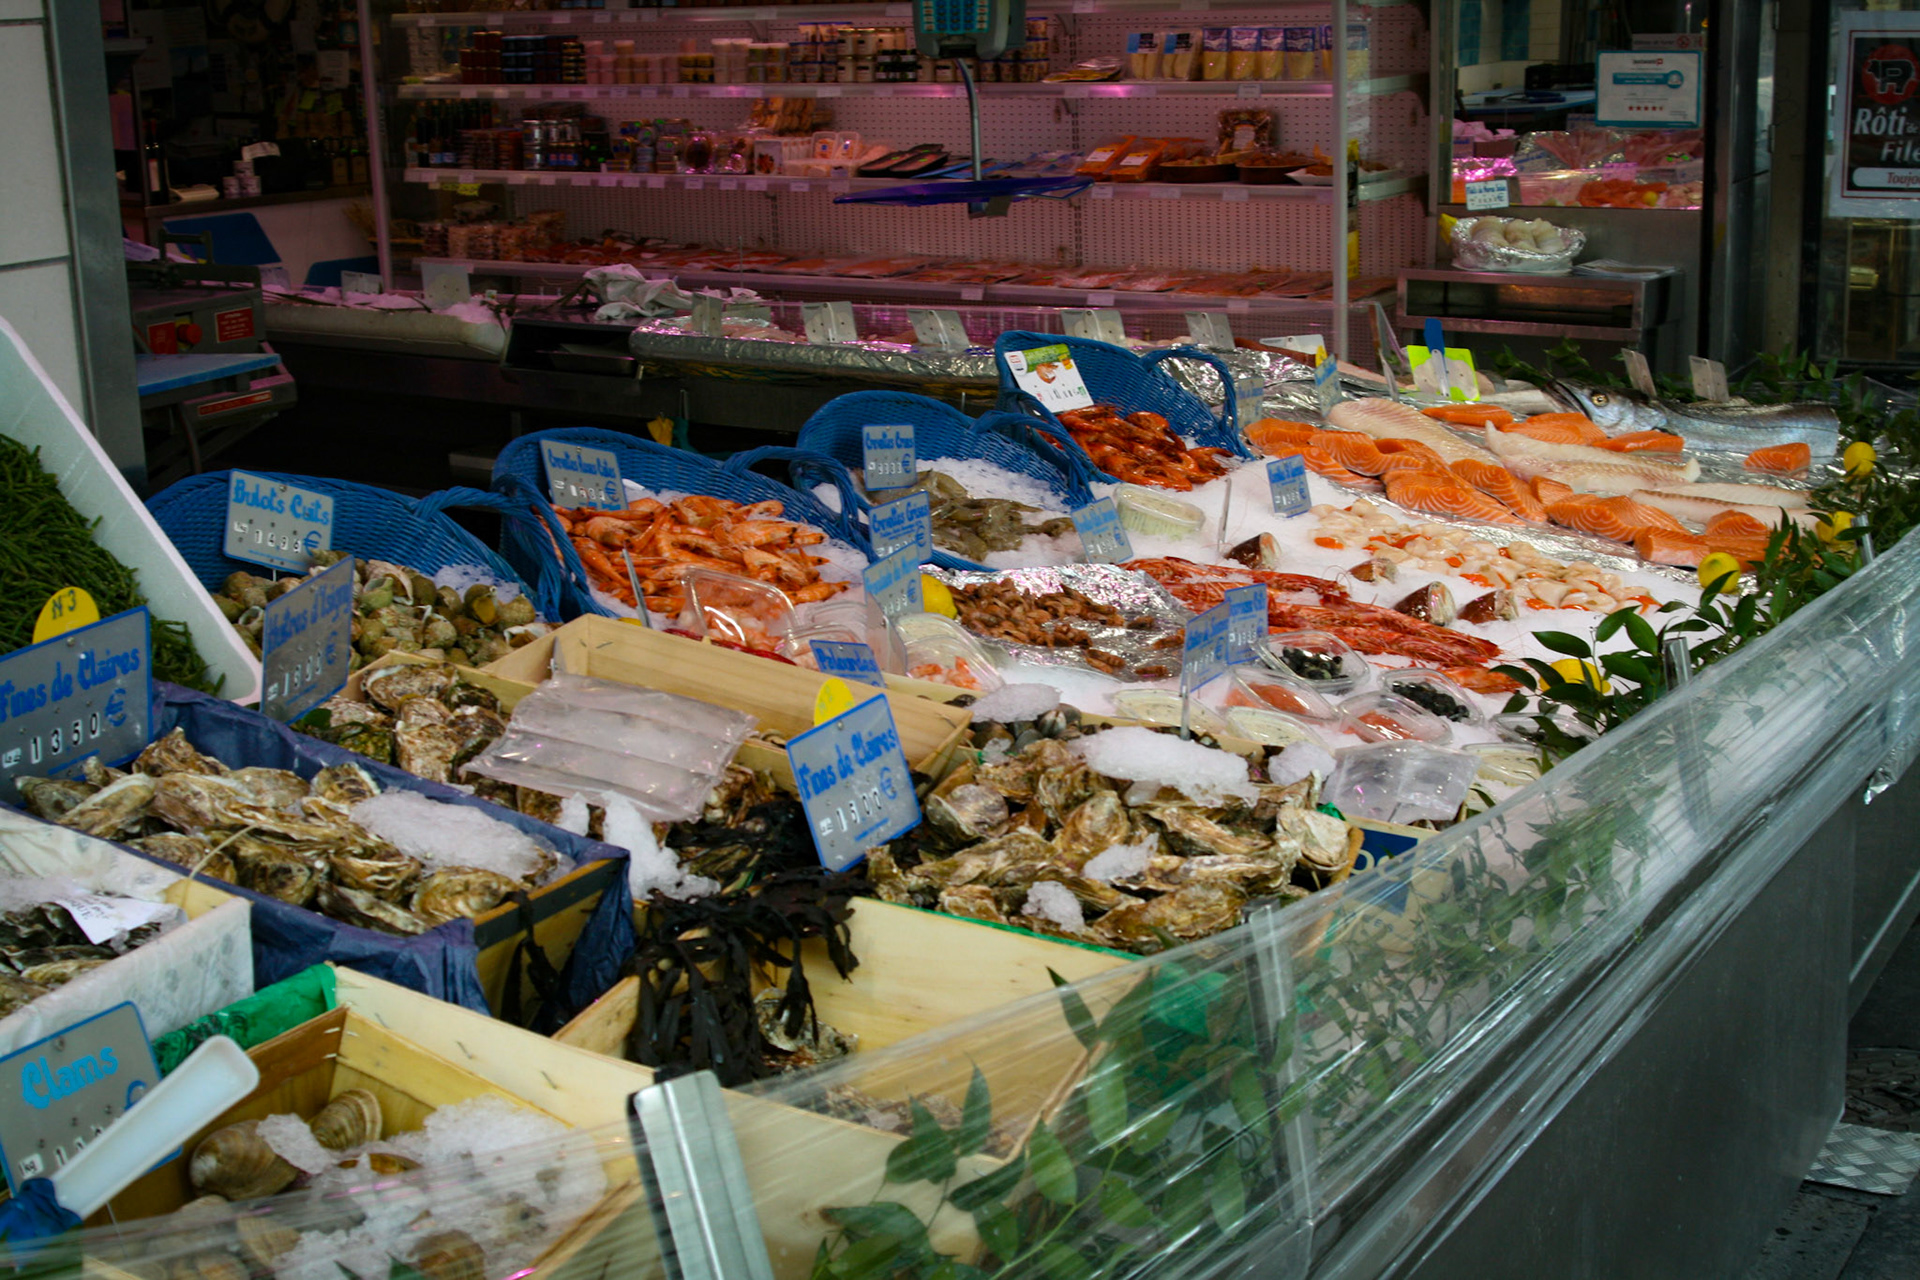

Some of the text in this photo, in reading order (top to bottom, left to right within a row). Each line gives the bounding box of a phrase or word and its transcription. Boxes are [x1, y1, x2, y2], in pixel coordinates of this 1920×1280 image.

[1854, 106, 1908, 135] Rôti
[1887, 170, 1920, 191] Toujo
[233, 478, 329, 526] Bulots Cuits
[50, 660, 74, 702] de
[76, 648, 140, 690] Claires
[815, 647, 879, 673] Palourdes
[798, 727, 897, 801] Fines de Claires
[21, 1046, 119, 1109] Clams
